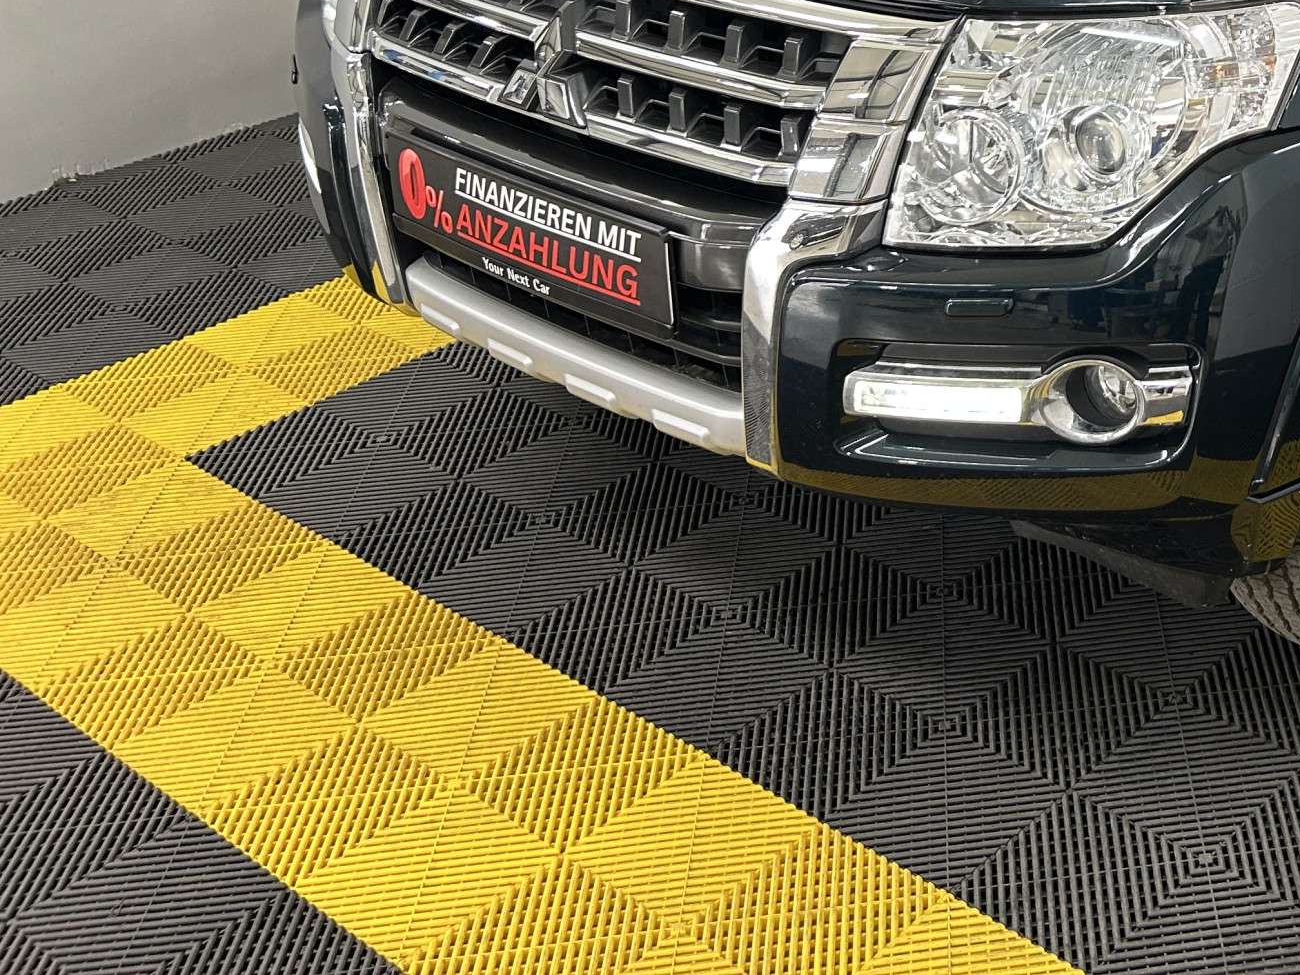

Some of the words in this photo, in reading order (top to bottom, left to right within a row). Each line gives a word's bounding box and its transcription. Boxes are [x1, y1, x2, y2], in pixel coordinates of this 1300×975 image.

[399, 147, 453, 234] 0%
[457, 204, 638, 298] ANZAHLUNG
[455, 167, 592, 239] FINANZIEREN
[599, 220, 642, 257] MIT
[482, 256, 504, 277] Your
[507, 269, 530, 288] Next
[533, 278, 550, 296] Car
